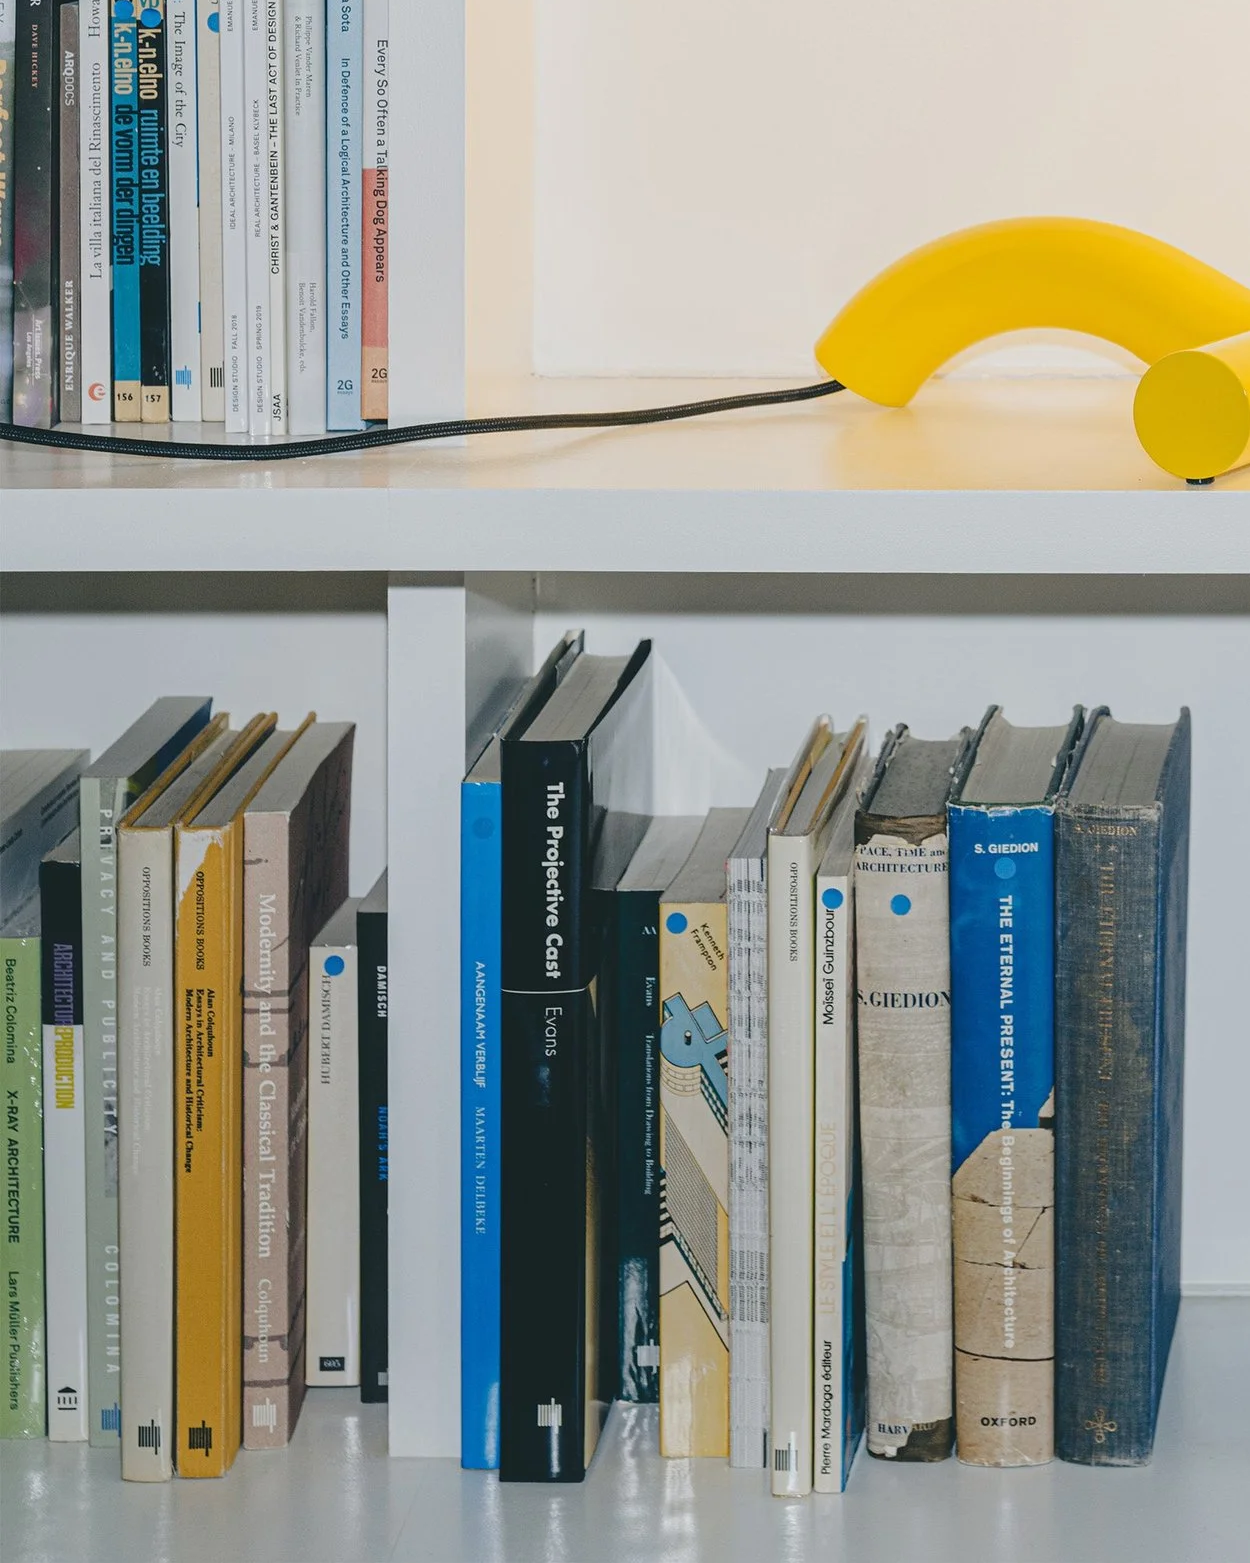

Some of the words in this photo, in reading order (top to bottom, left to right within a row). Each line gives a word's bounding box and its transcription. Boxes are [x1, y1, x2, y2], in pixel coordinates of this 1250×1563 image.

[171, 41, 186, 76] Image
[374, 39, 388, 76] Every
[175, 81, 187, 95] of
[175, 98, 187, 119] the
[376, 79, 388, 96] So
[172, 123, 187, 148] City
[376, 99, 388, 136] Often
[270, 150, 280, 221] GANTENBEIN
[271, 235, 280, 274] CHRIST
[116, 393, 134, 402] 156
[546, 782, 566, 819] The
[541, 826, 565, 928] Projective
[1000, 895, 1013, 928] THE
[545, 933, 564, 979] Cast
[1000, 934, 1013, 1009] ETERNAL
[475, 961, 486, 1044] AANGENAAM
[545, 1007, 563, 1057] Evans
[475, 1045, 486, 1089] VERBLIJF
[1001, 1015, 1014, 1096] PRESENT:
[6, 1090, 19, 1133] X-RAY
[257, 1080, 277, 1162] Classical
[7, 1138, 20, 1244] ARCHITECTURE
[257, 1169, 277, 1259] Tradition
[104, 1245, 120, 1373] COLOMINA
[821, 1340, 832, 1380] éditeur
[821, 1383, 833, 1439] Mardaga
[980, 1415, 1037, 1427] OXFORD
